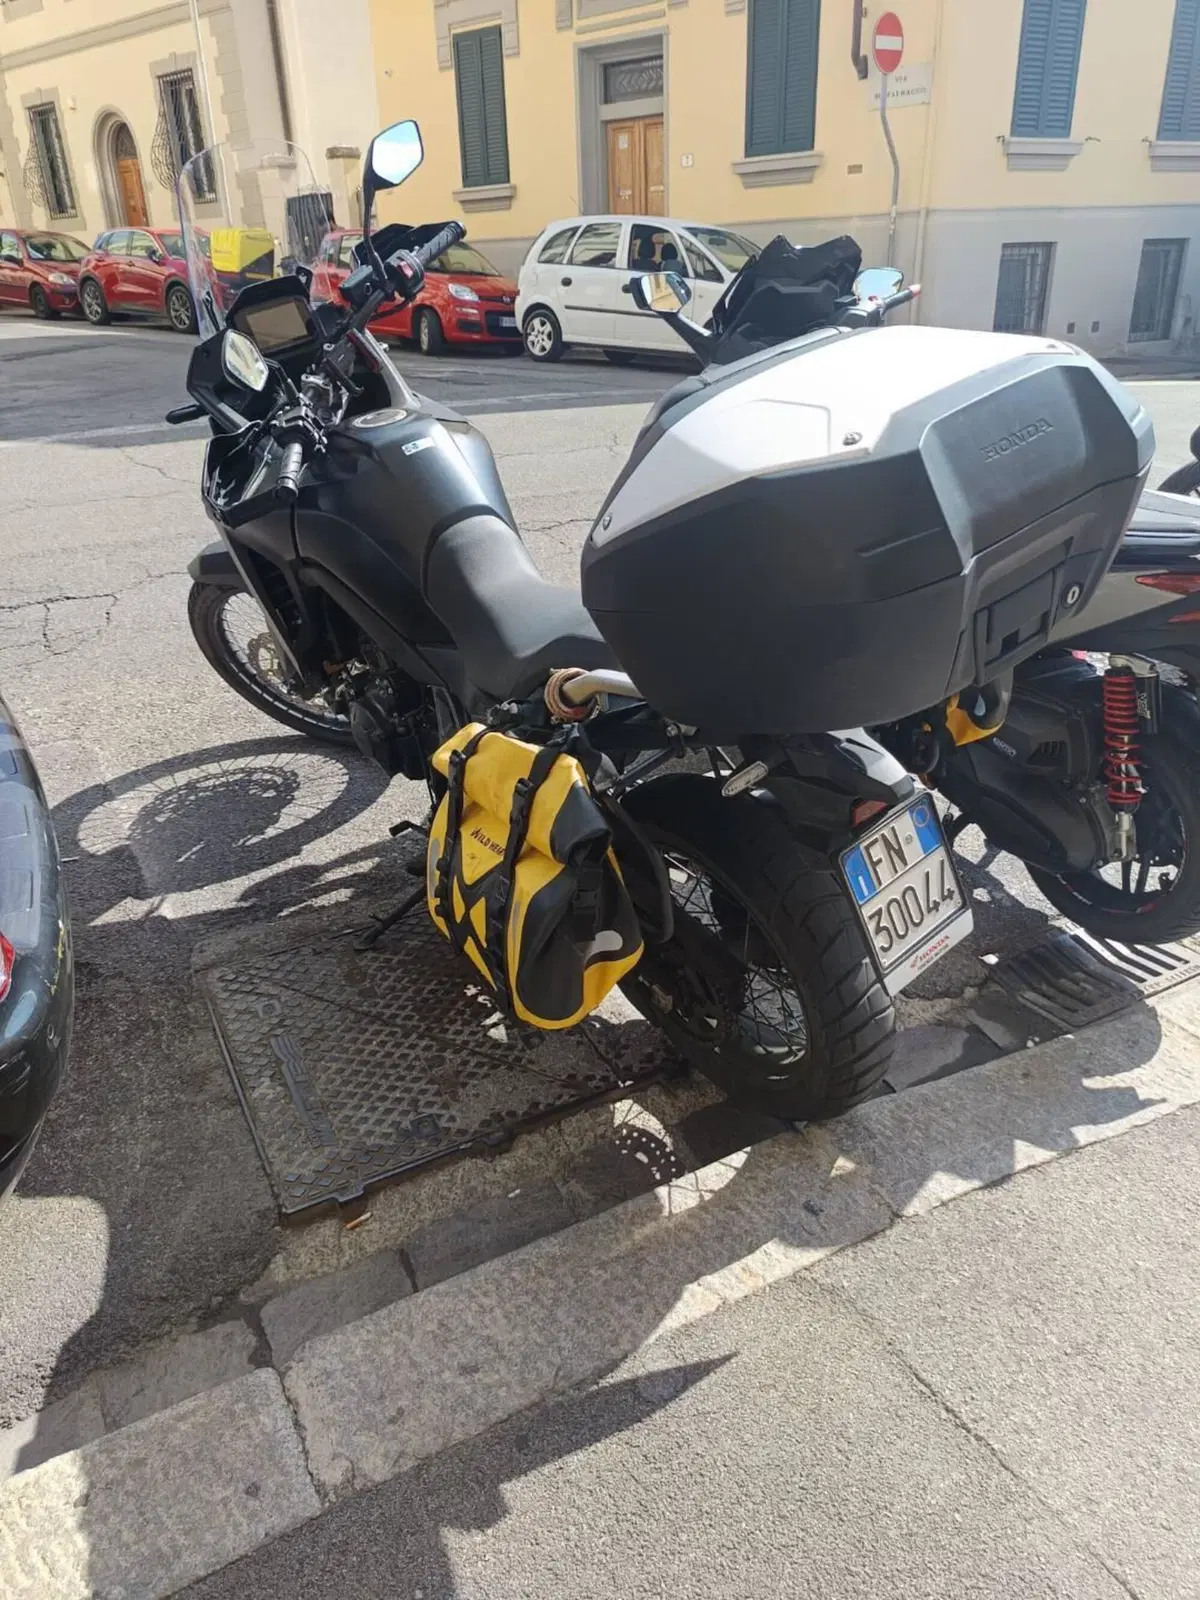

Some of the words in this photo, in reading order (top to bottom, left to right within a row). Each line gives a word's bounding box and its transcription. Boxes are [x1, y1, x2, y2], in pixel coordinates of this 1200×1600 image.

[980, 418, 1053, 463] HONDA
[470, 827, 491, 848] WILD
[864, 826, 908, 887] FN
[868, 859, 955, 953] 30044
